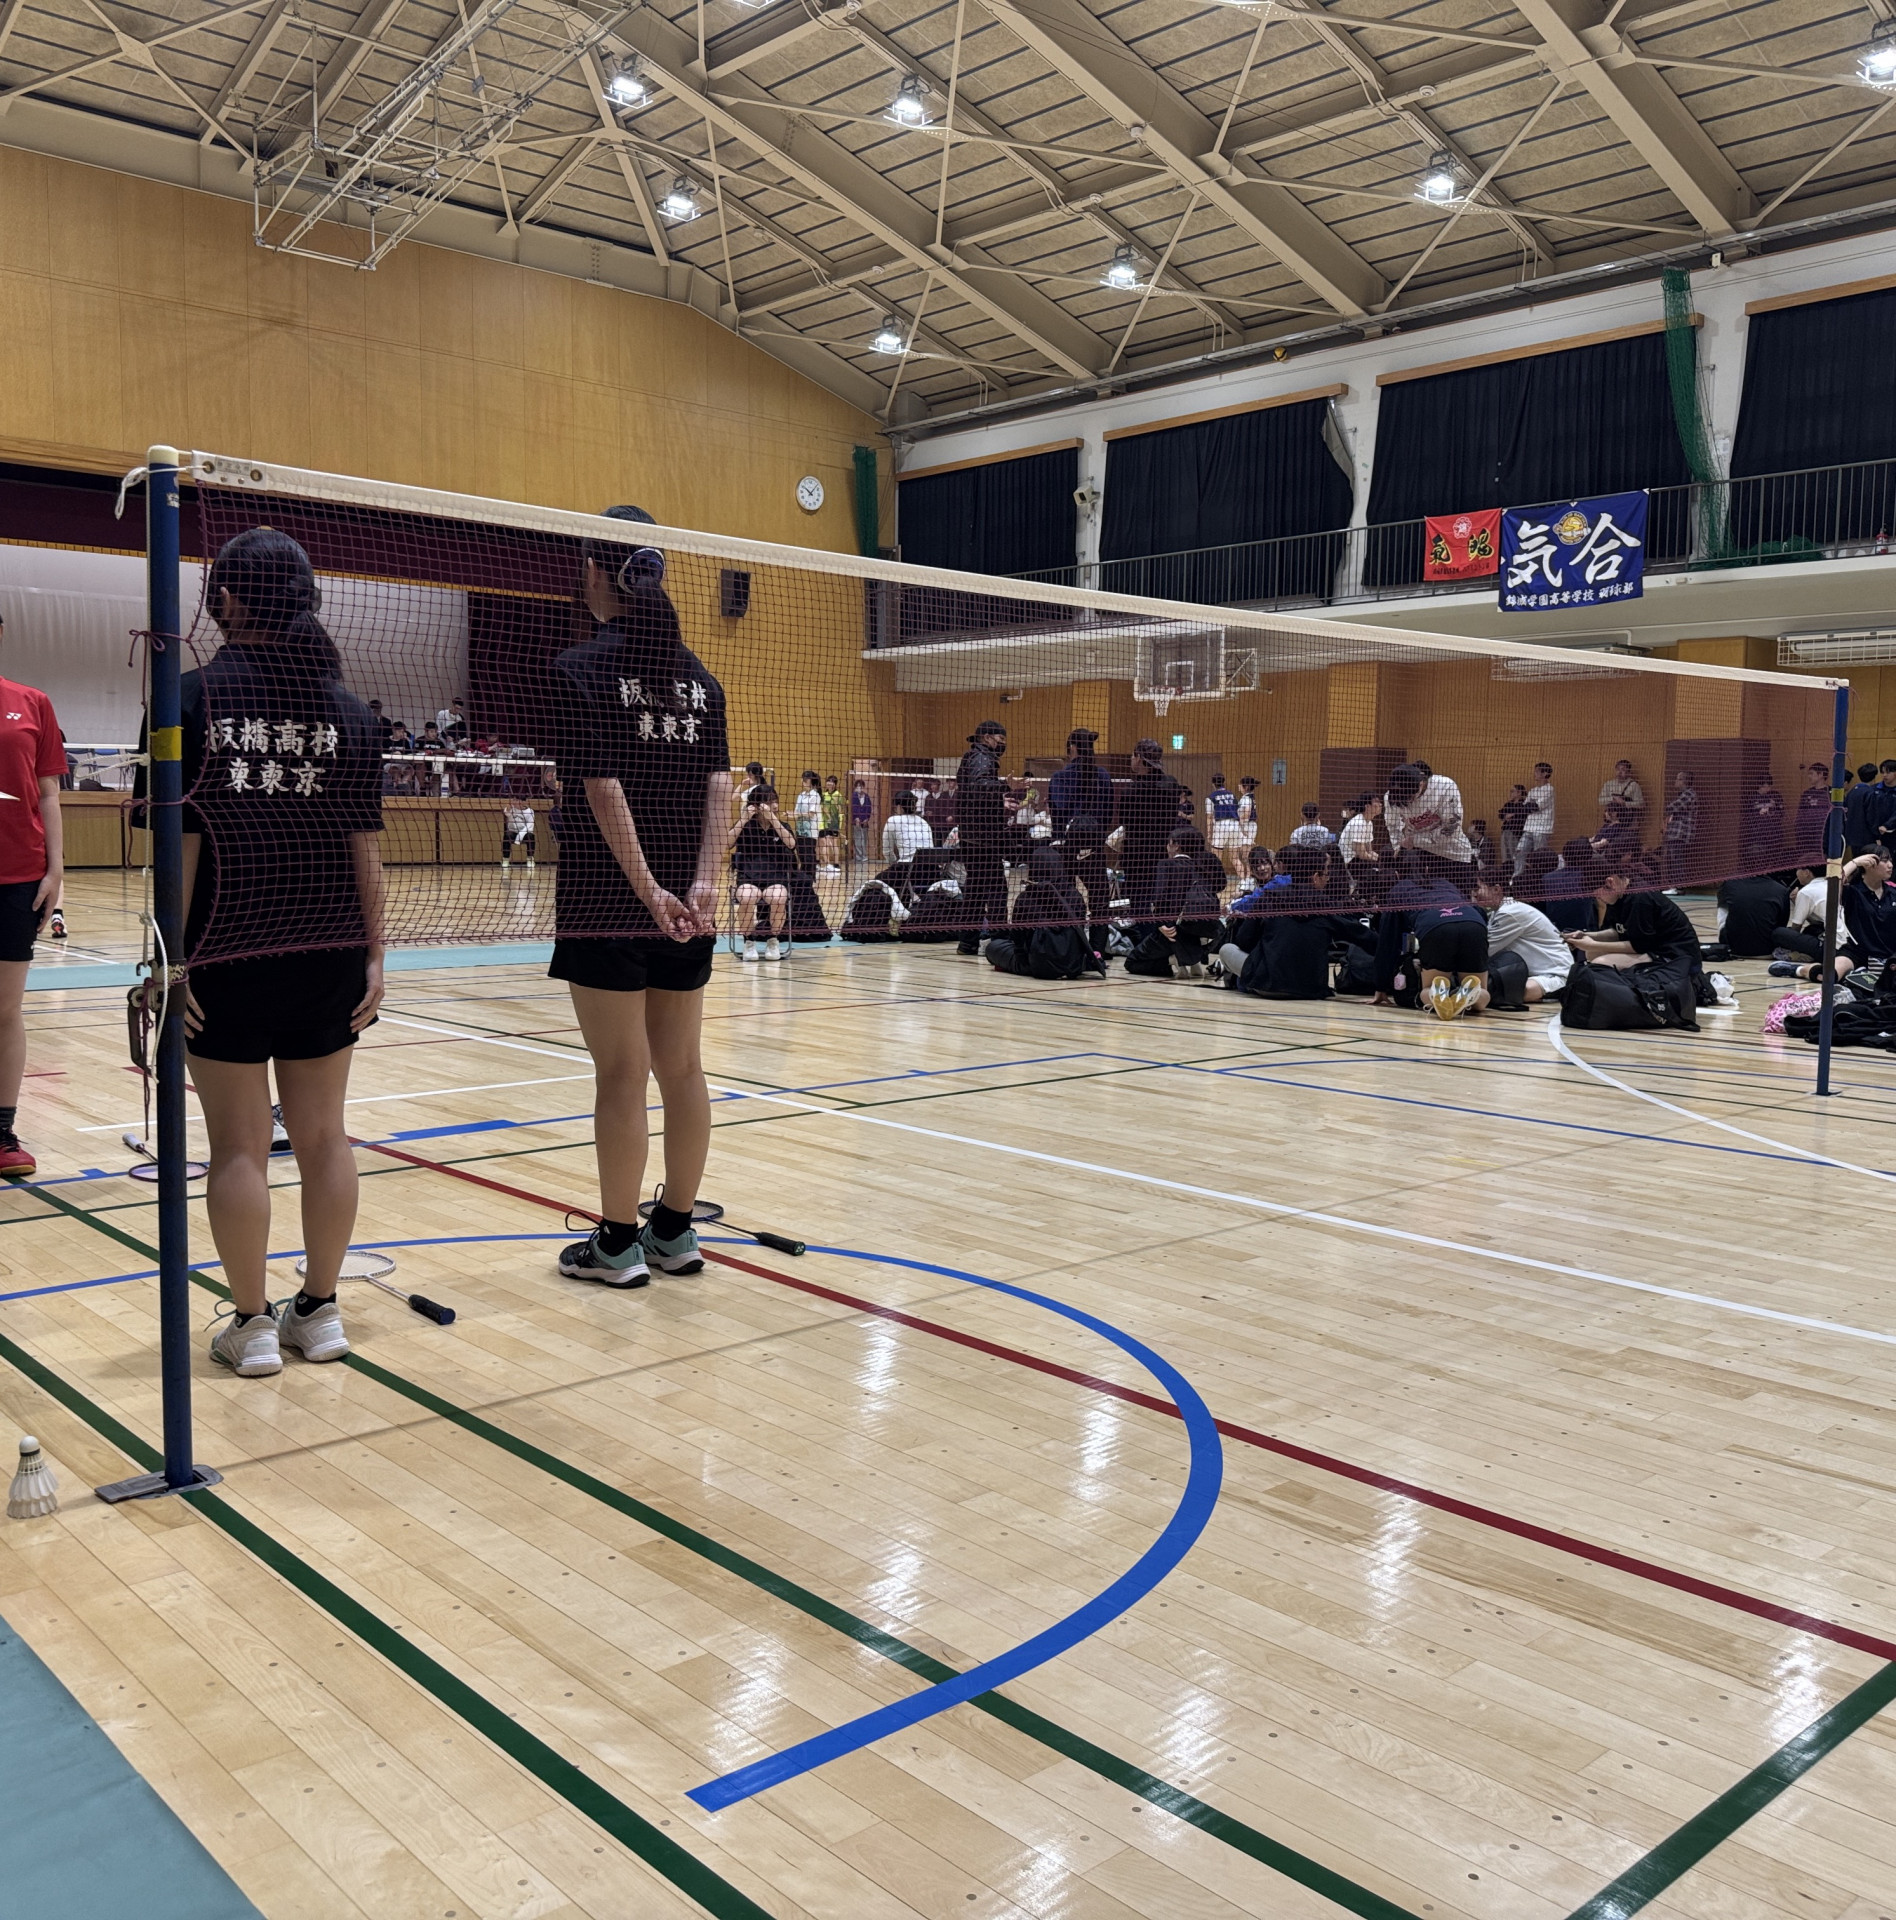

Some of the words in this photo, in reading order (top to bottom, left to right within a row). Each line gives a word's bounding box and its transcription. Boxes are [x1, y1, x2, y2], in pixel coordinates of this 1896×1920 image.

[1507, 512, 1642, 588] 気合
[205, 717, 338, 760] 板橋高校
[637, 711, 702, 744] 東東京
[224, 757, 326, 797] 東東京
